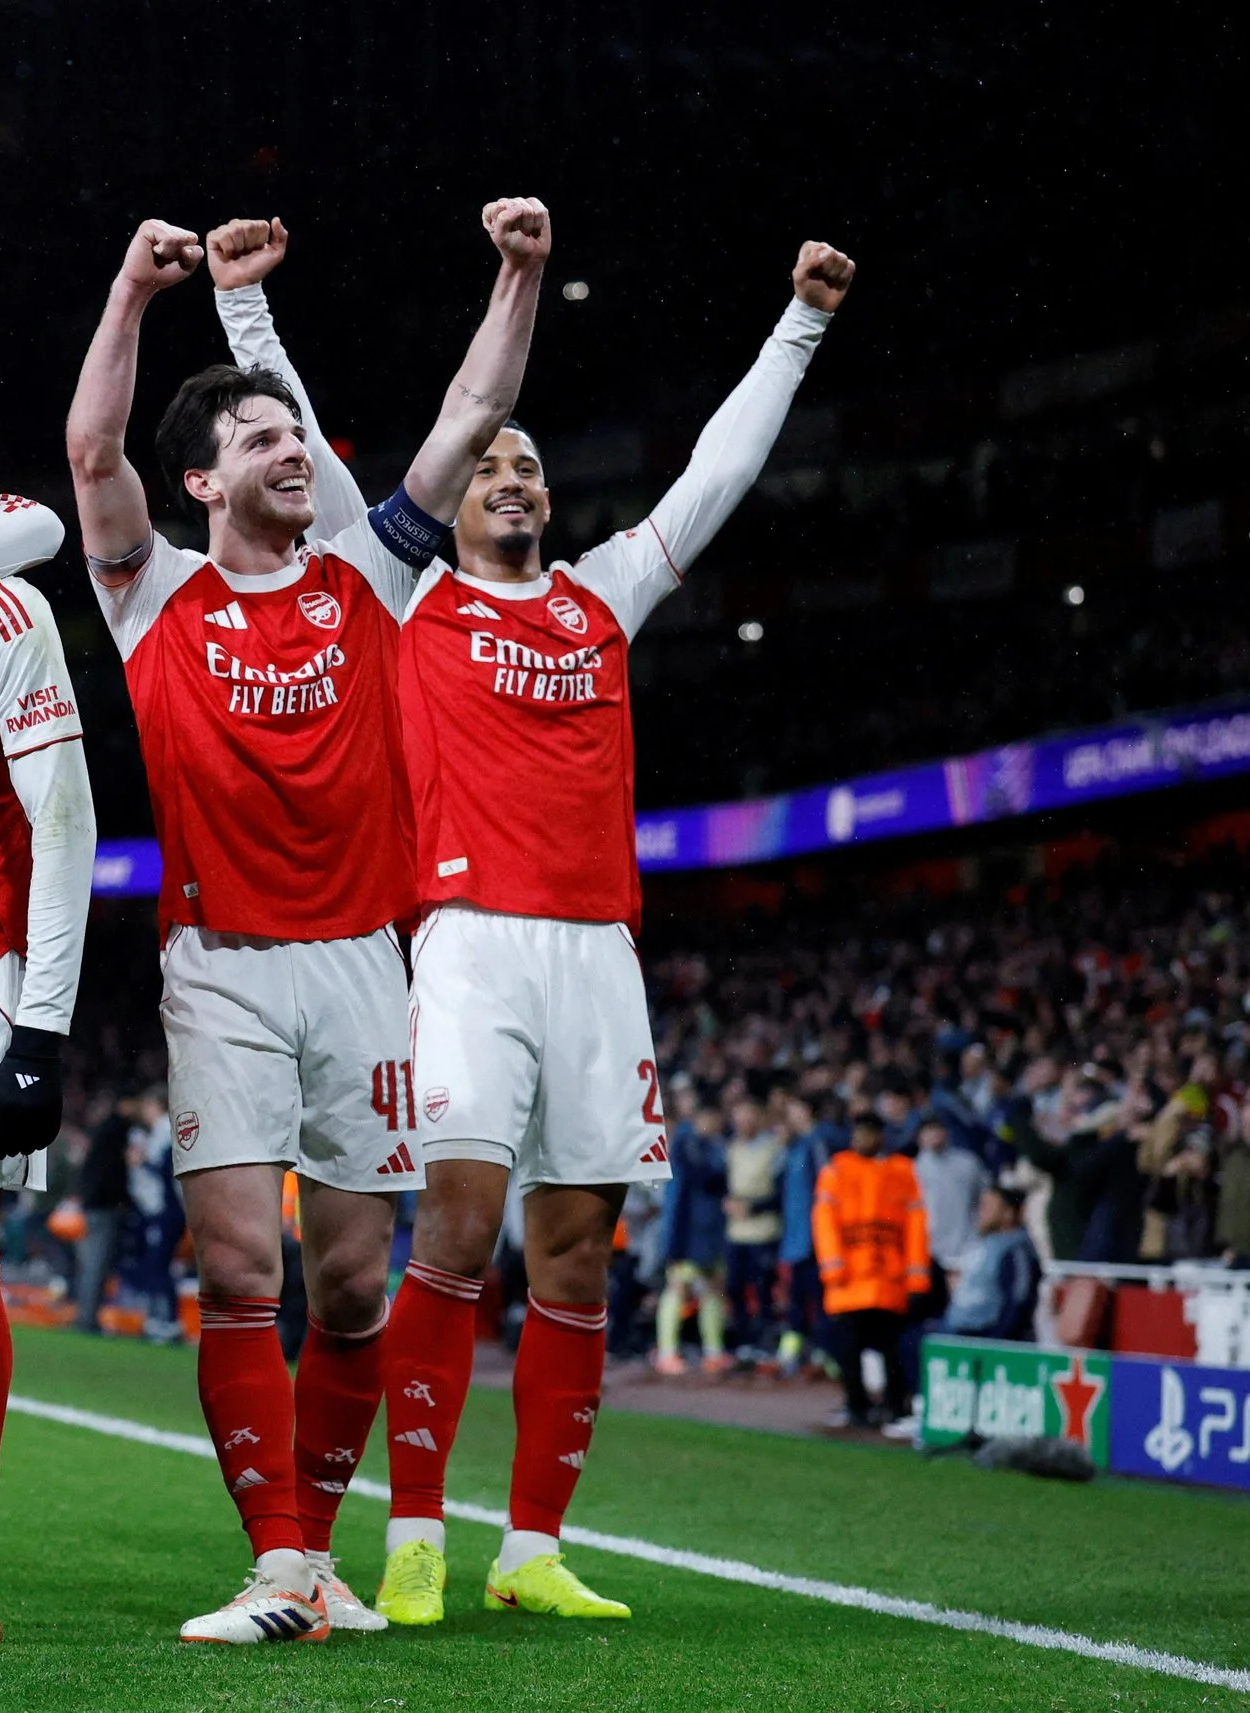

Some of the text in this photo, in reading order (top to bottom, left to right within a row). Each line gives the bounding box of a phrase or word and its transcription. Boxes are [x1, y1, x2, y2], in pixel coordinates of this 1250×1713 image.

[382, 517, 411, 549] RACISM
[394, 511, 430, 542] RESPECT
[17, 685, 59, 711] VISIT
[228, 676, 339, 716] FLY BETTER
[494, 668, 597, 702] FLY BETTER
[6, 701, 76, 733] RWANDA
[371, 1059, 417, 1132] 41
[637, 1060, 665, 1124] 2
